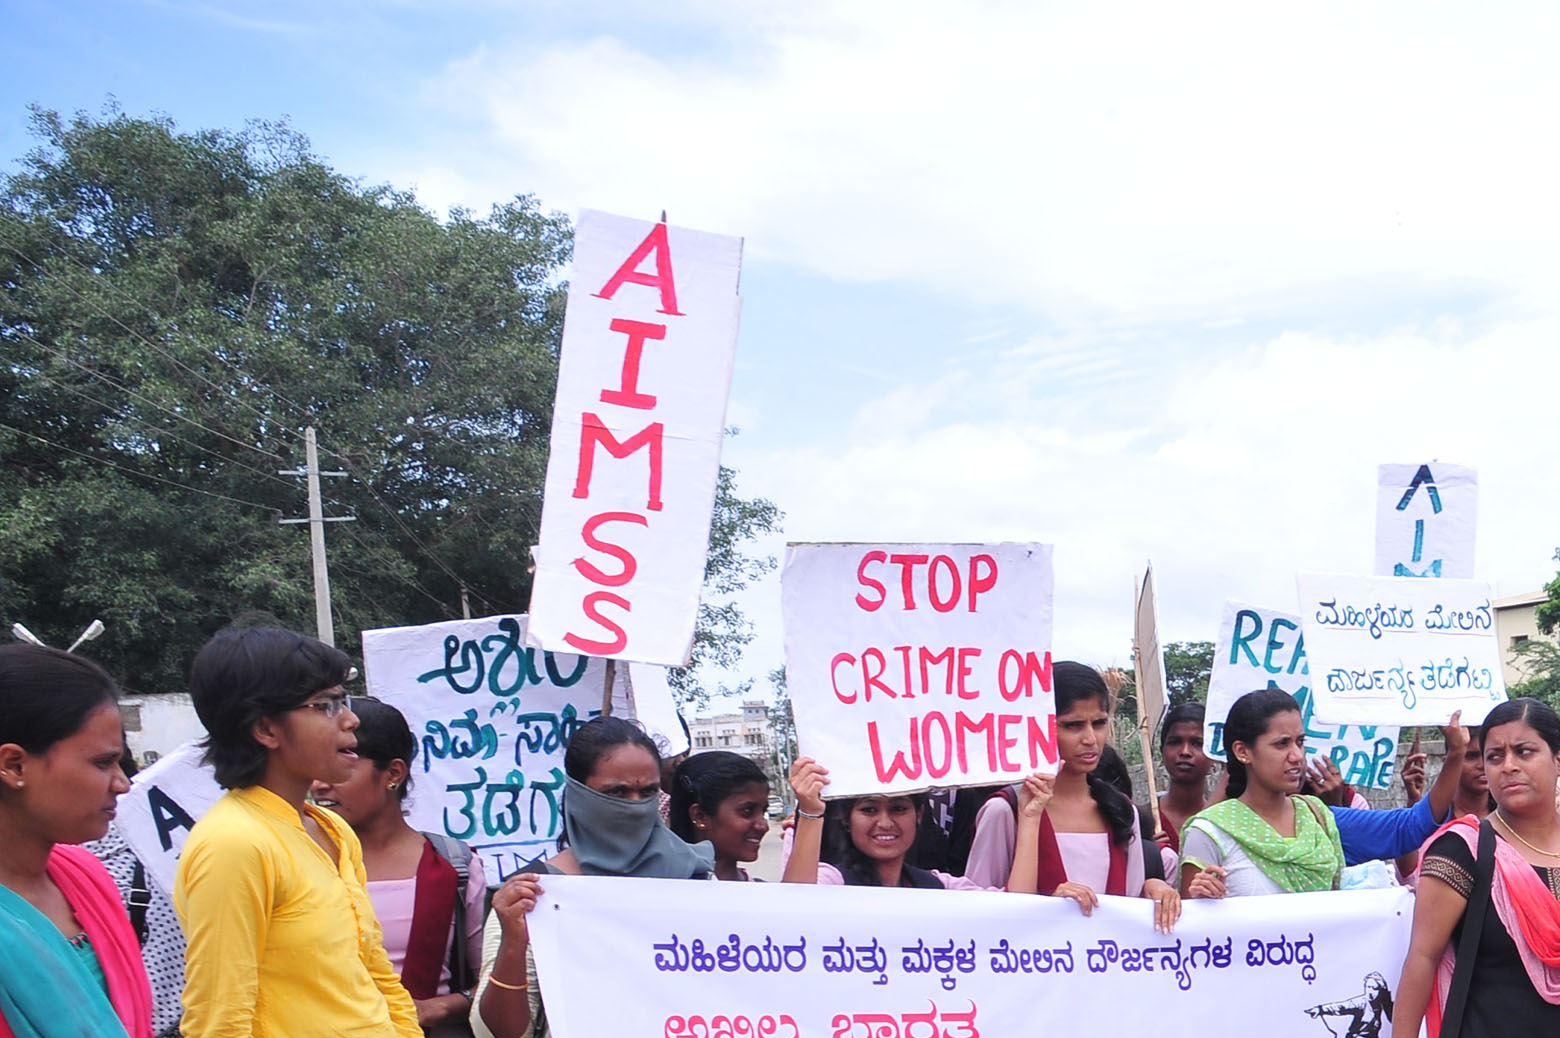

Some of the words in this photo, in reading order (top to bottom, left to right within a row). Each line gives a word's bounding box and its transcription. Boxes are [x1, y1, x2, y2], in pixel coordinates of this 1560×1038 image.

[562, 222, 687, 656] AIMSS
[855, 550, 998, 613] STOP
[1229, 609, 1309, 675] REA
[1425, 599, 1492, 631] ಮೇಲಿನ
[831, 645, 982, 704] CRIME
[998, 649, 1052, 702] ON
[867, 710, 1058, 784] WOMEN
[1330, 737, 1394, 789] RAPE
[653, 933, 807, 973] ಮಹಿಳೆಯರ
[822, 936, 888, 986] ಮತ್ತು
[901, 937, 976, 991] ಮಕ್ಕಳ
[989, 938, 1074, 974] ಮೇಲಿನ
[1086, 936, 1233, 991] ದೌರ್ಜನ್ಯಗಳ
[1245, 932, 1317, 985] ವಿರುದ್ಧ
